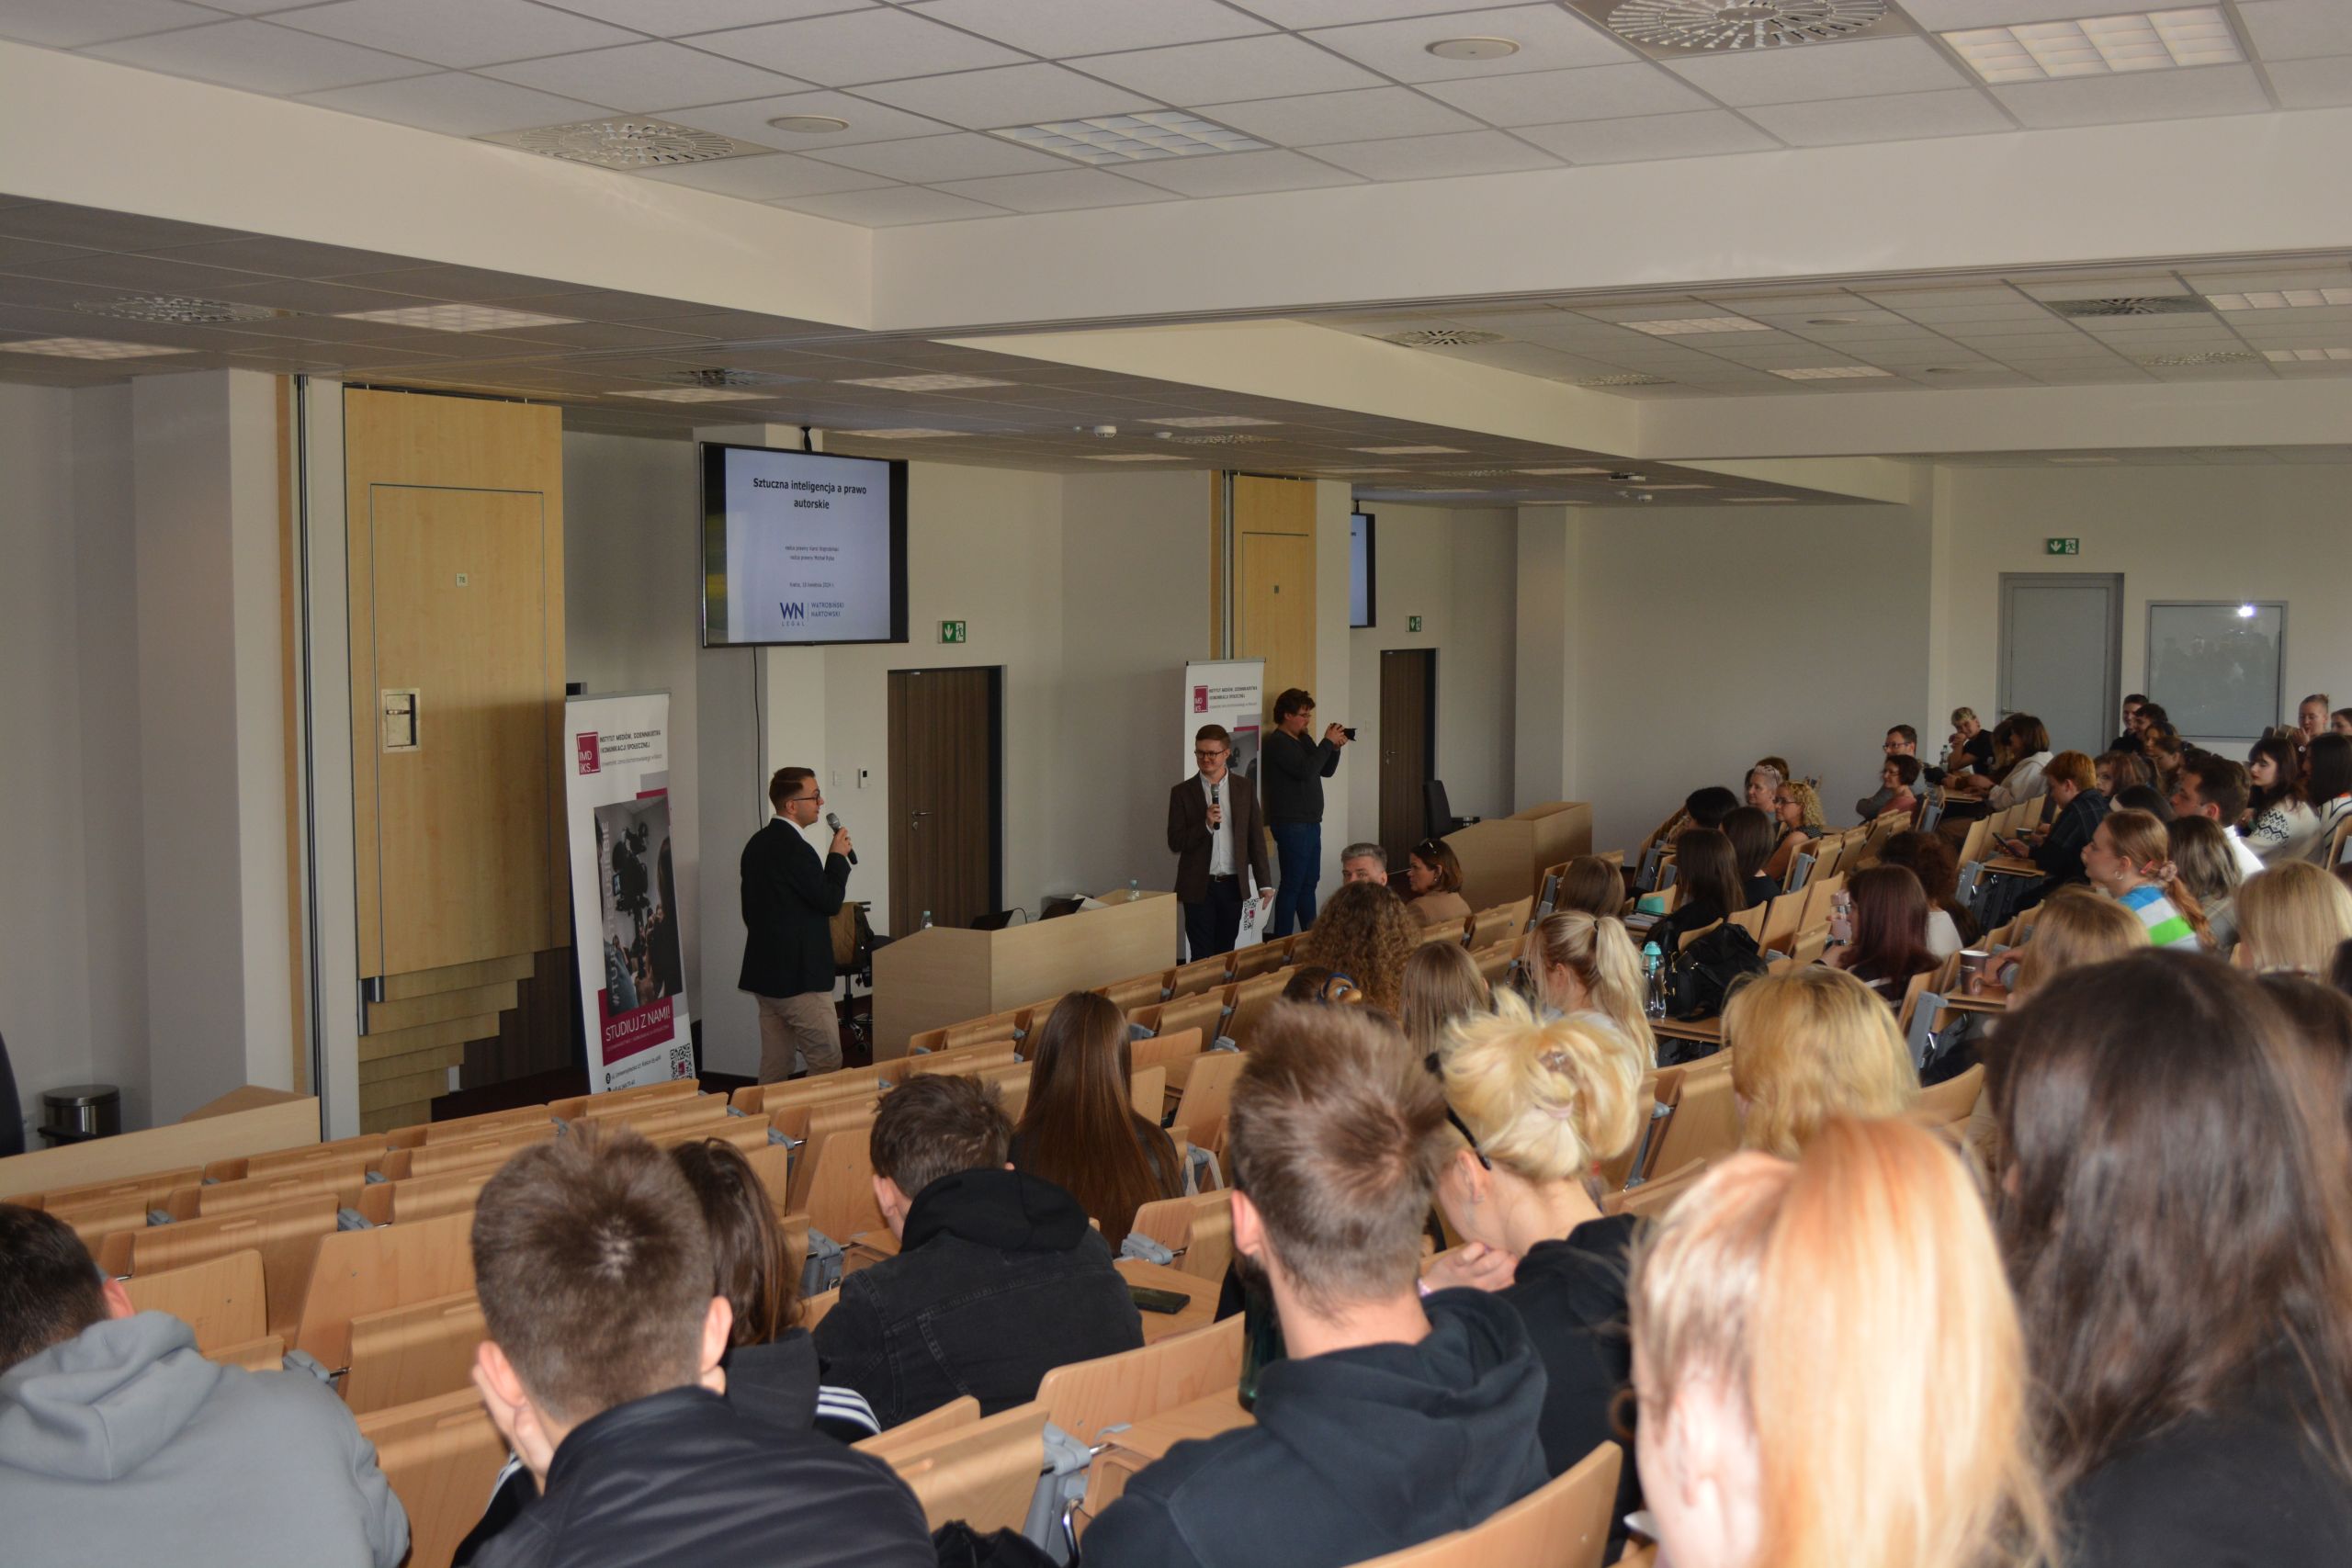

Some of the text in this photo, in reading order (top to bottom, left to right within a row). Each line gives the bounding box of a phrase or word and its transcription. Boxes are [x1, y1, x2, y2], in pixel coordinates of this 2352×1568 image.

[752, 478, 789, 490] Sztuczna
[791, 480, 836, 494] inteligencja
[843, 485, 867, 495] prawo
[794, 499, 830, 509] autorskie
[779, 602, 805, 620] WN
[605, 1019, 639, 1042] STUDIUJ
[640, 1014, 647, 1029] Z
[647, 1005, 671, 1024] NAMI!
